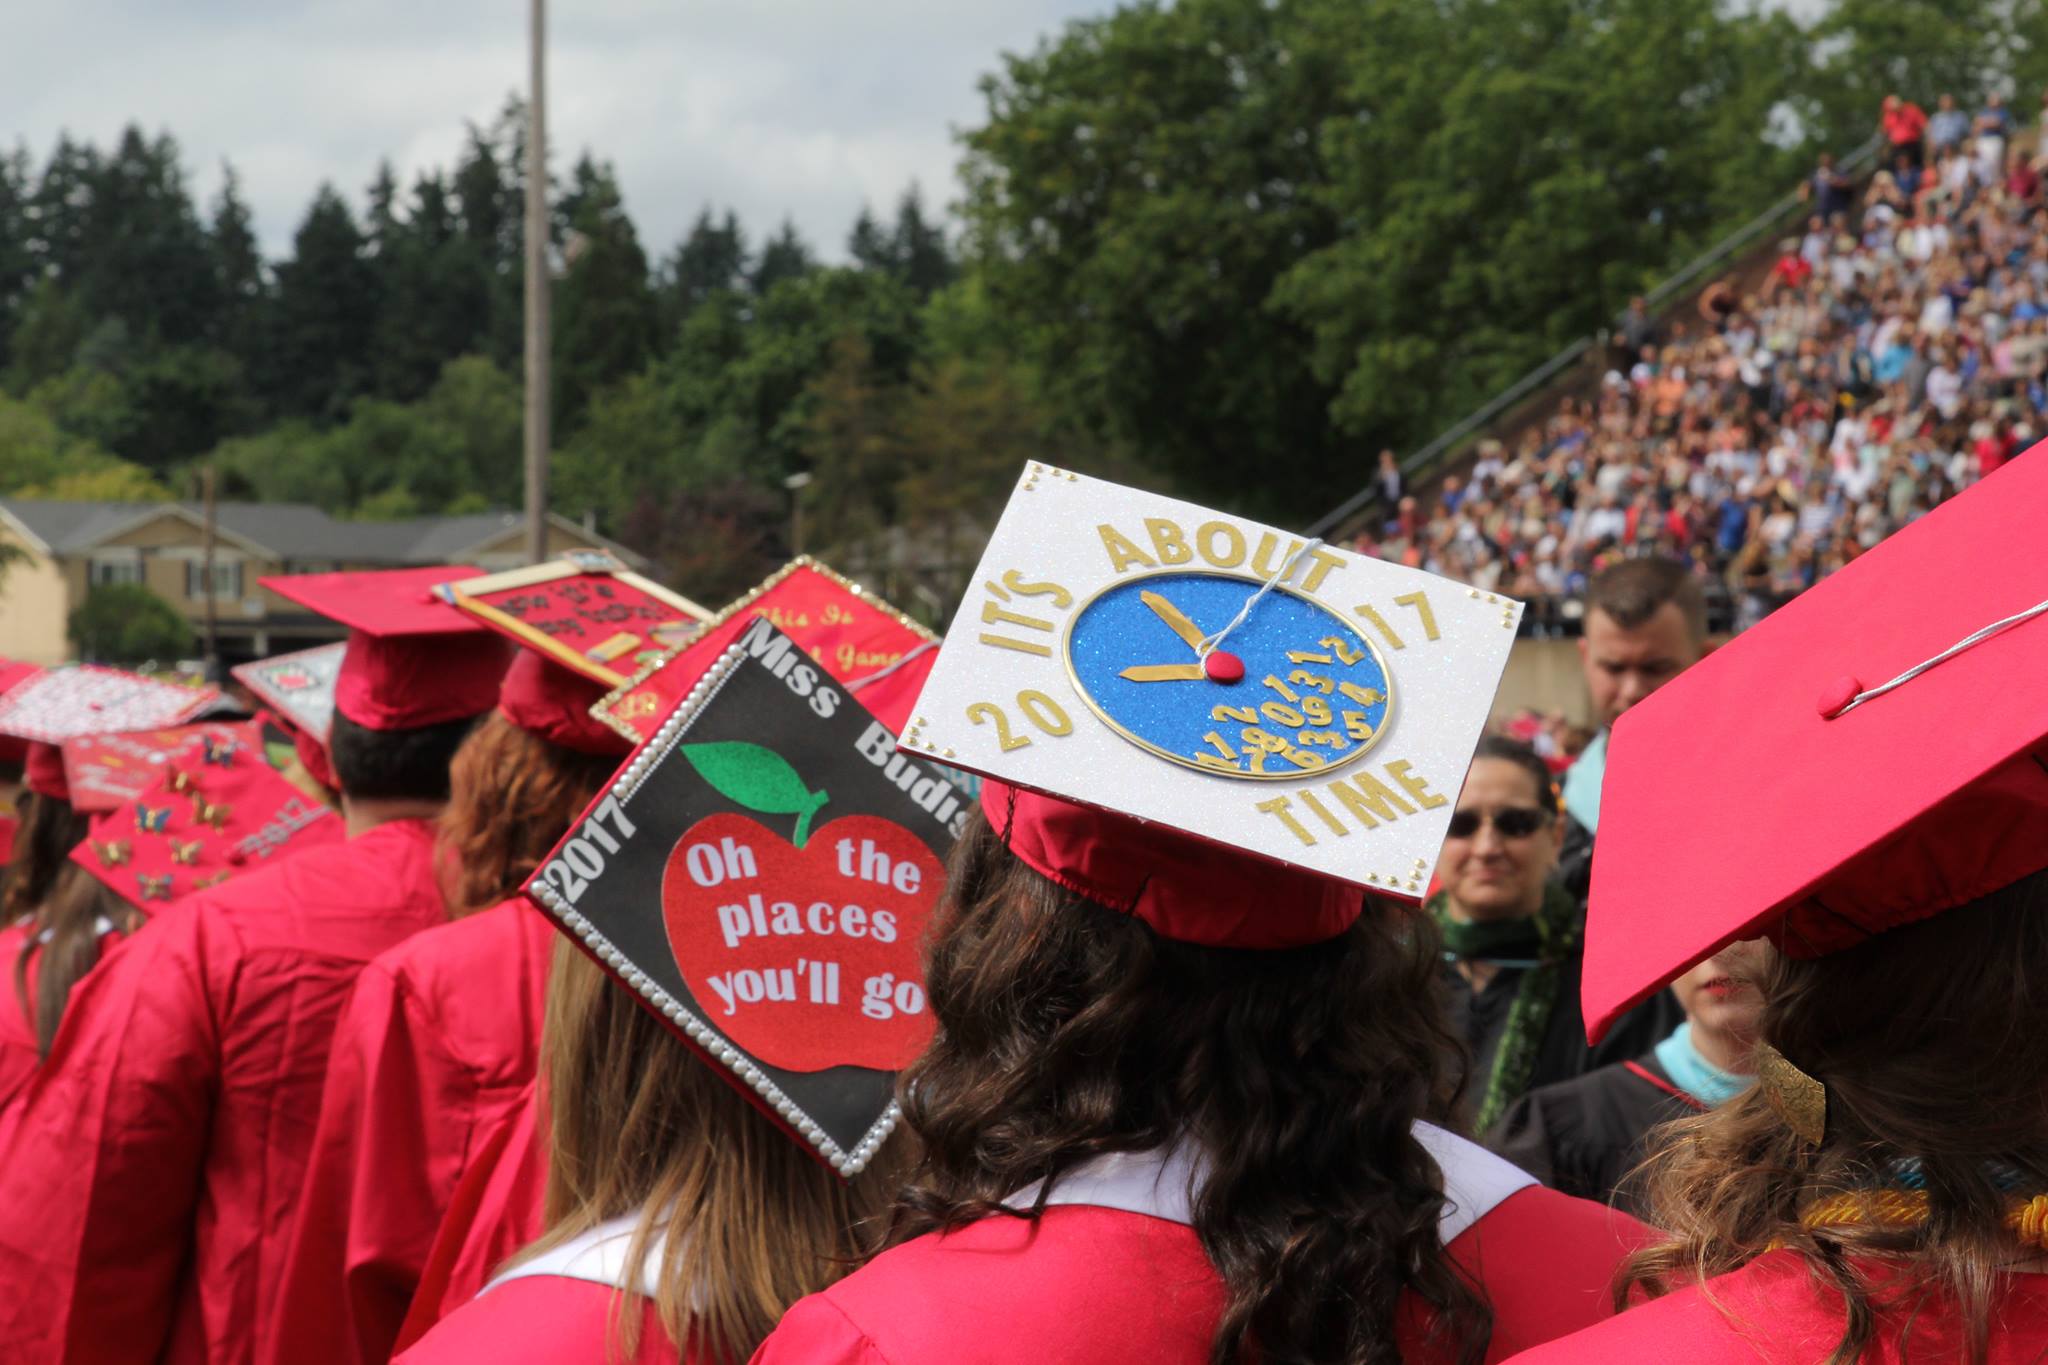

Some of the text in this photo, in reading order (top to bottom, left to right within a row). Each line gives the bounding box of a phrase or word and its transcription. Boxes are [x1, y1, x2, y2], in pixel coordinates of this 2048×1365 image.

[979, 517, 1347, 657] IT'S ABOUT
[1354, 590, 1441, 649] 17
[966, 688, 1074, 753] 20
[1255, 759, 1449, 847] TIME
[543, 793, 637, 905] 2017
[686, 837, 921, 895] Oh the
[717, 894, 897, 948] places
[706, 958, 925, 1020] you'll go
